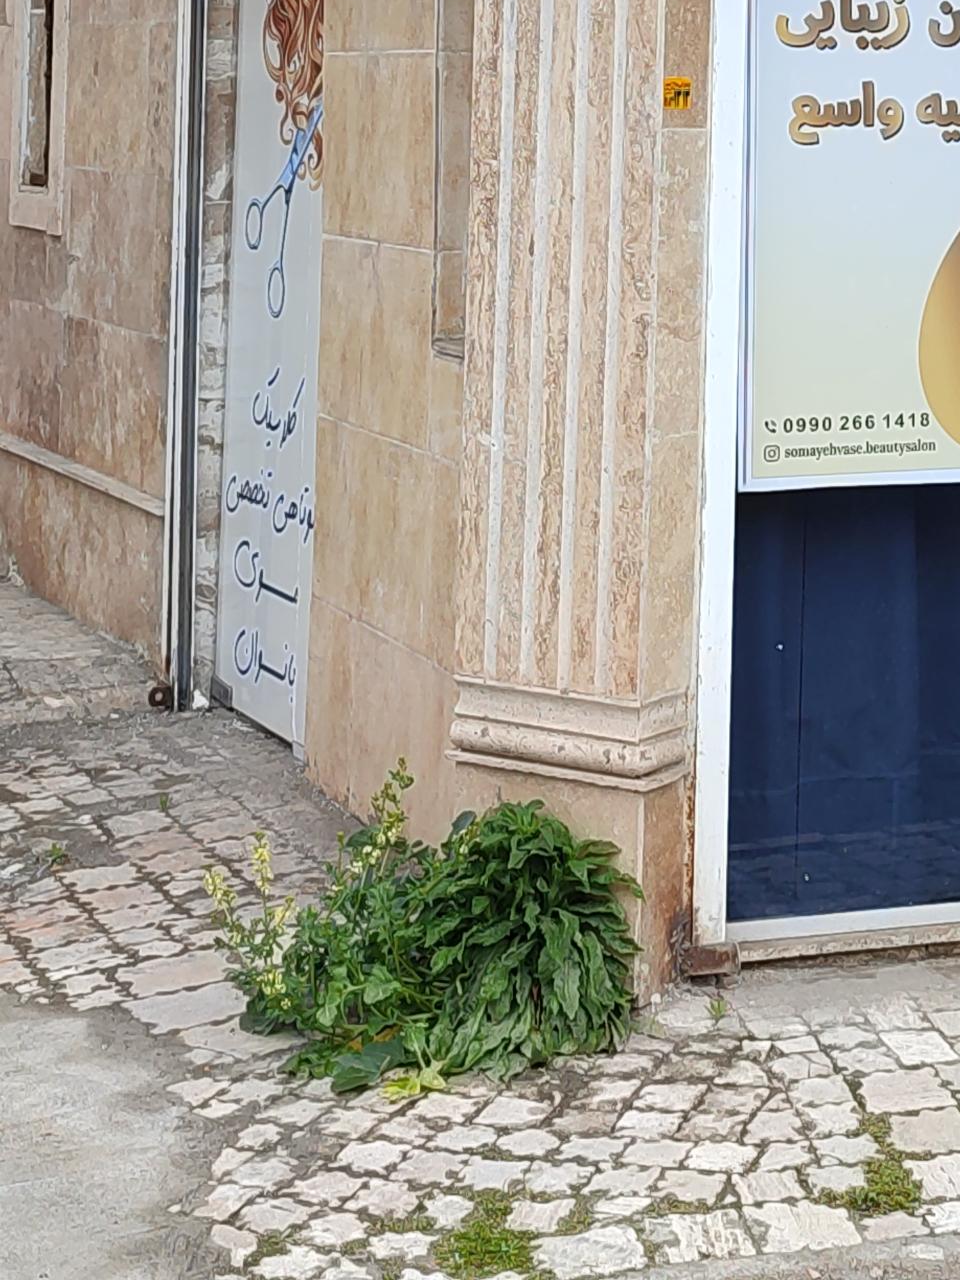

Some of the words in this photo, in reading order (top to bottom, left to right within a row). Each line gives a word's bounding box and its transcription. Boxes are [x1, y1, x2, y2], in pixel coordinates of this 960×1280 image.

[788, 81, 904, 145] واسع
[783, 417, 832, 434] 0990
[839, 414, 876, 431] 266
[882, 411, 931, 428] 1418
[784, 438, 937, 461] somayehvase.beautysalon
[273, 486, 314, 544] وتاهی
